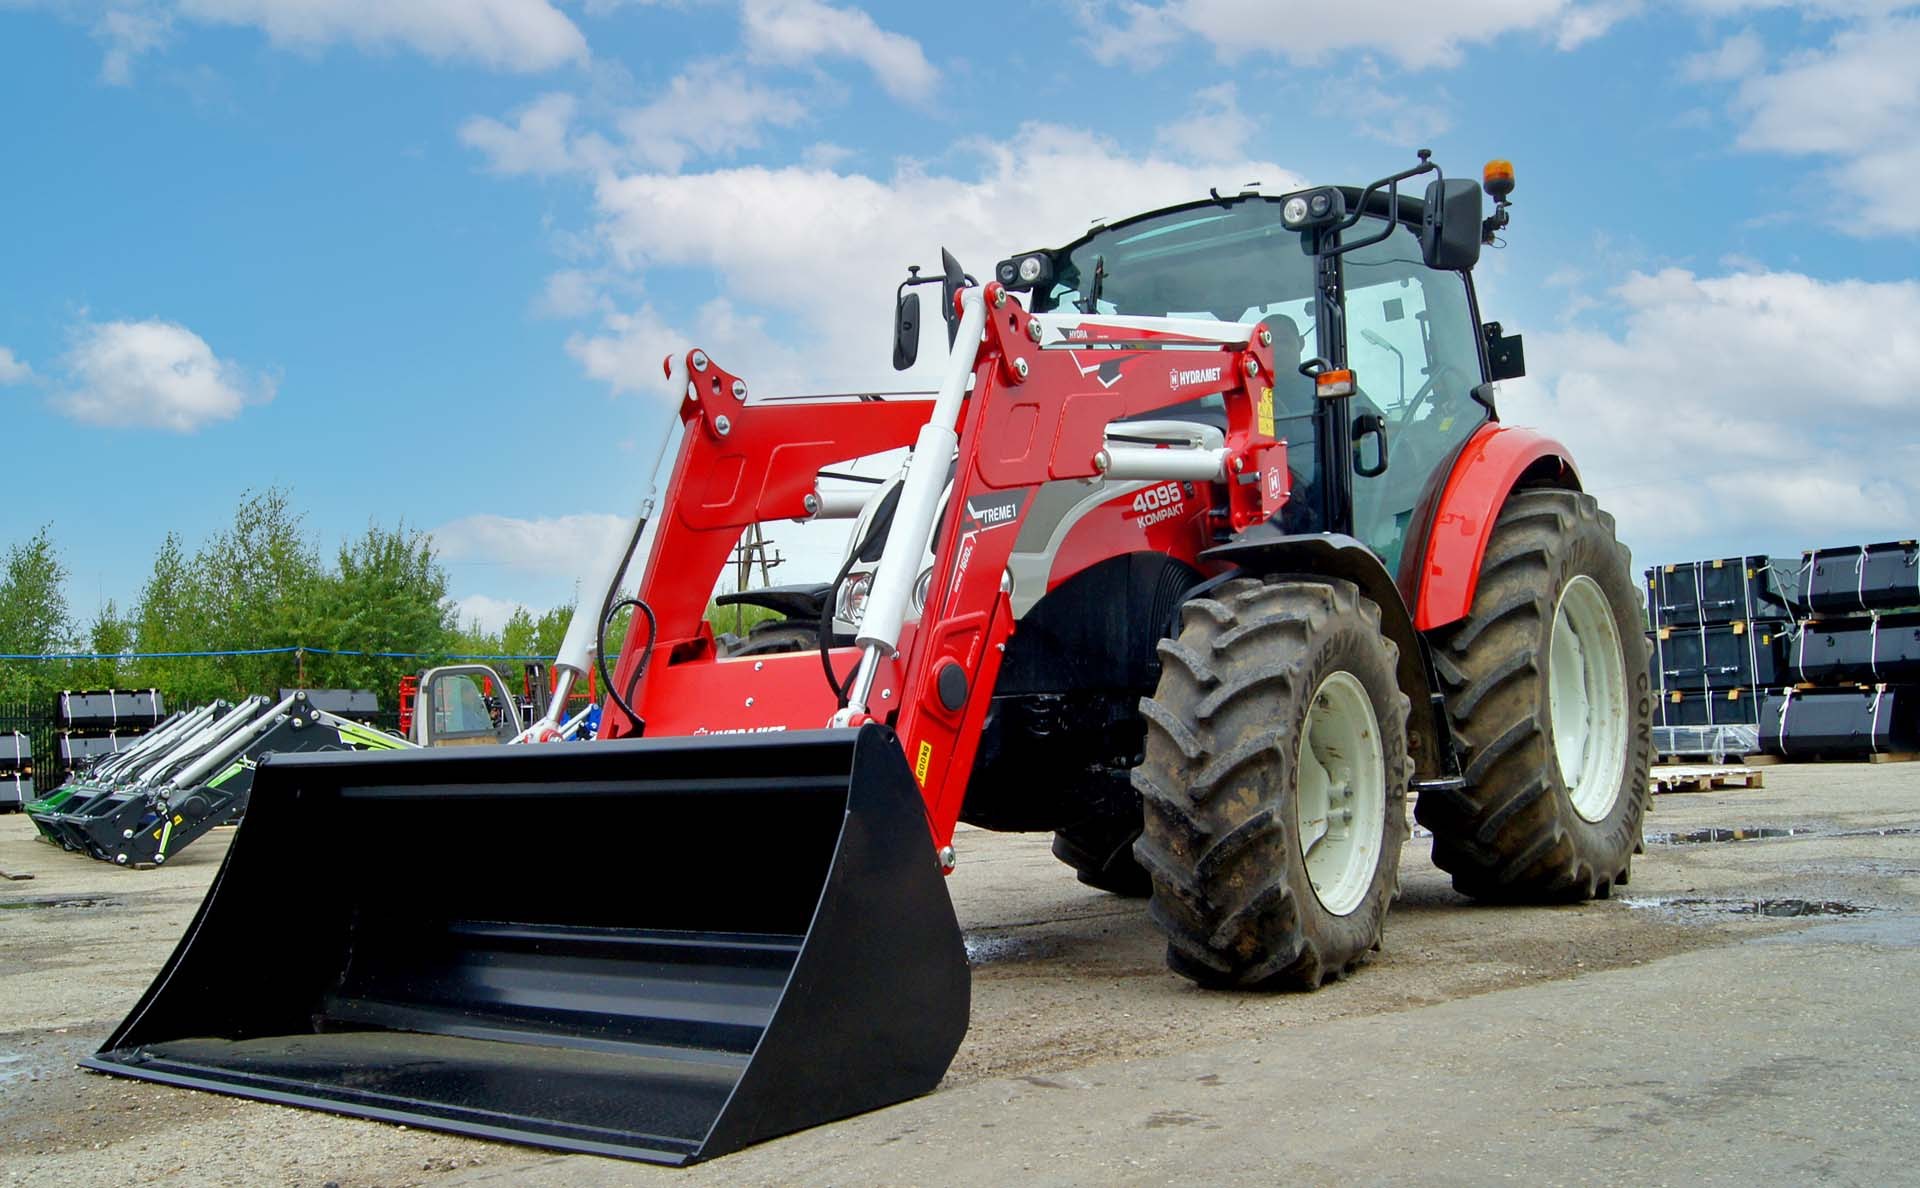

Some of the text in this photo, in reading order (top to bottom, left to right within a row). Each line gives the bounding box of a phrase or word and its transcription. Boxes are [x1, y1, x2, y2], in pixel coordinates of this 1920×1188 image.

[1180, 367, 1221, 386] HYDRAMET
[1133, 482, 1182, 513] 4095
[1136, 503, 1184, 529] KOMPAKT
